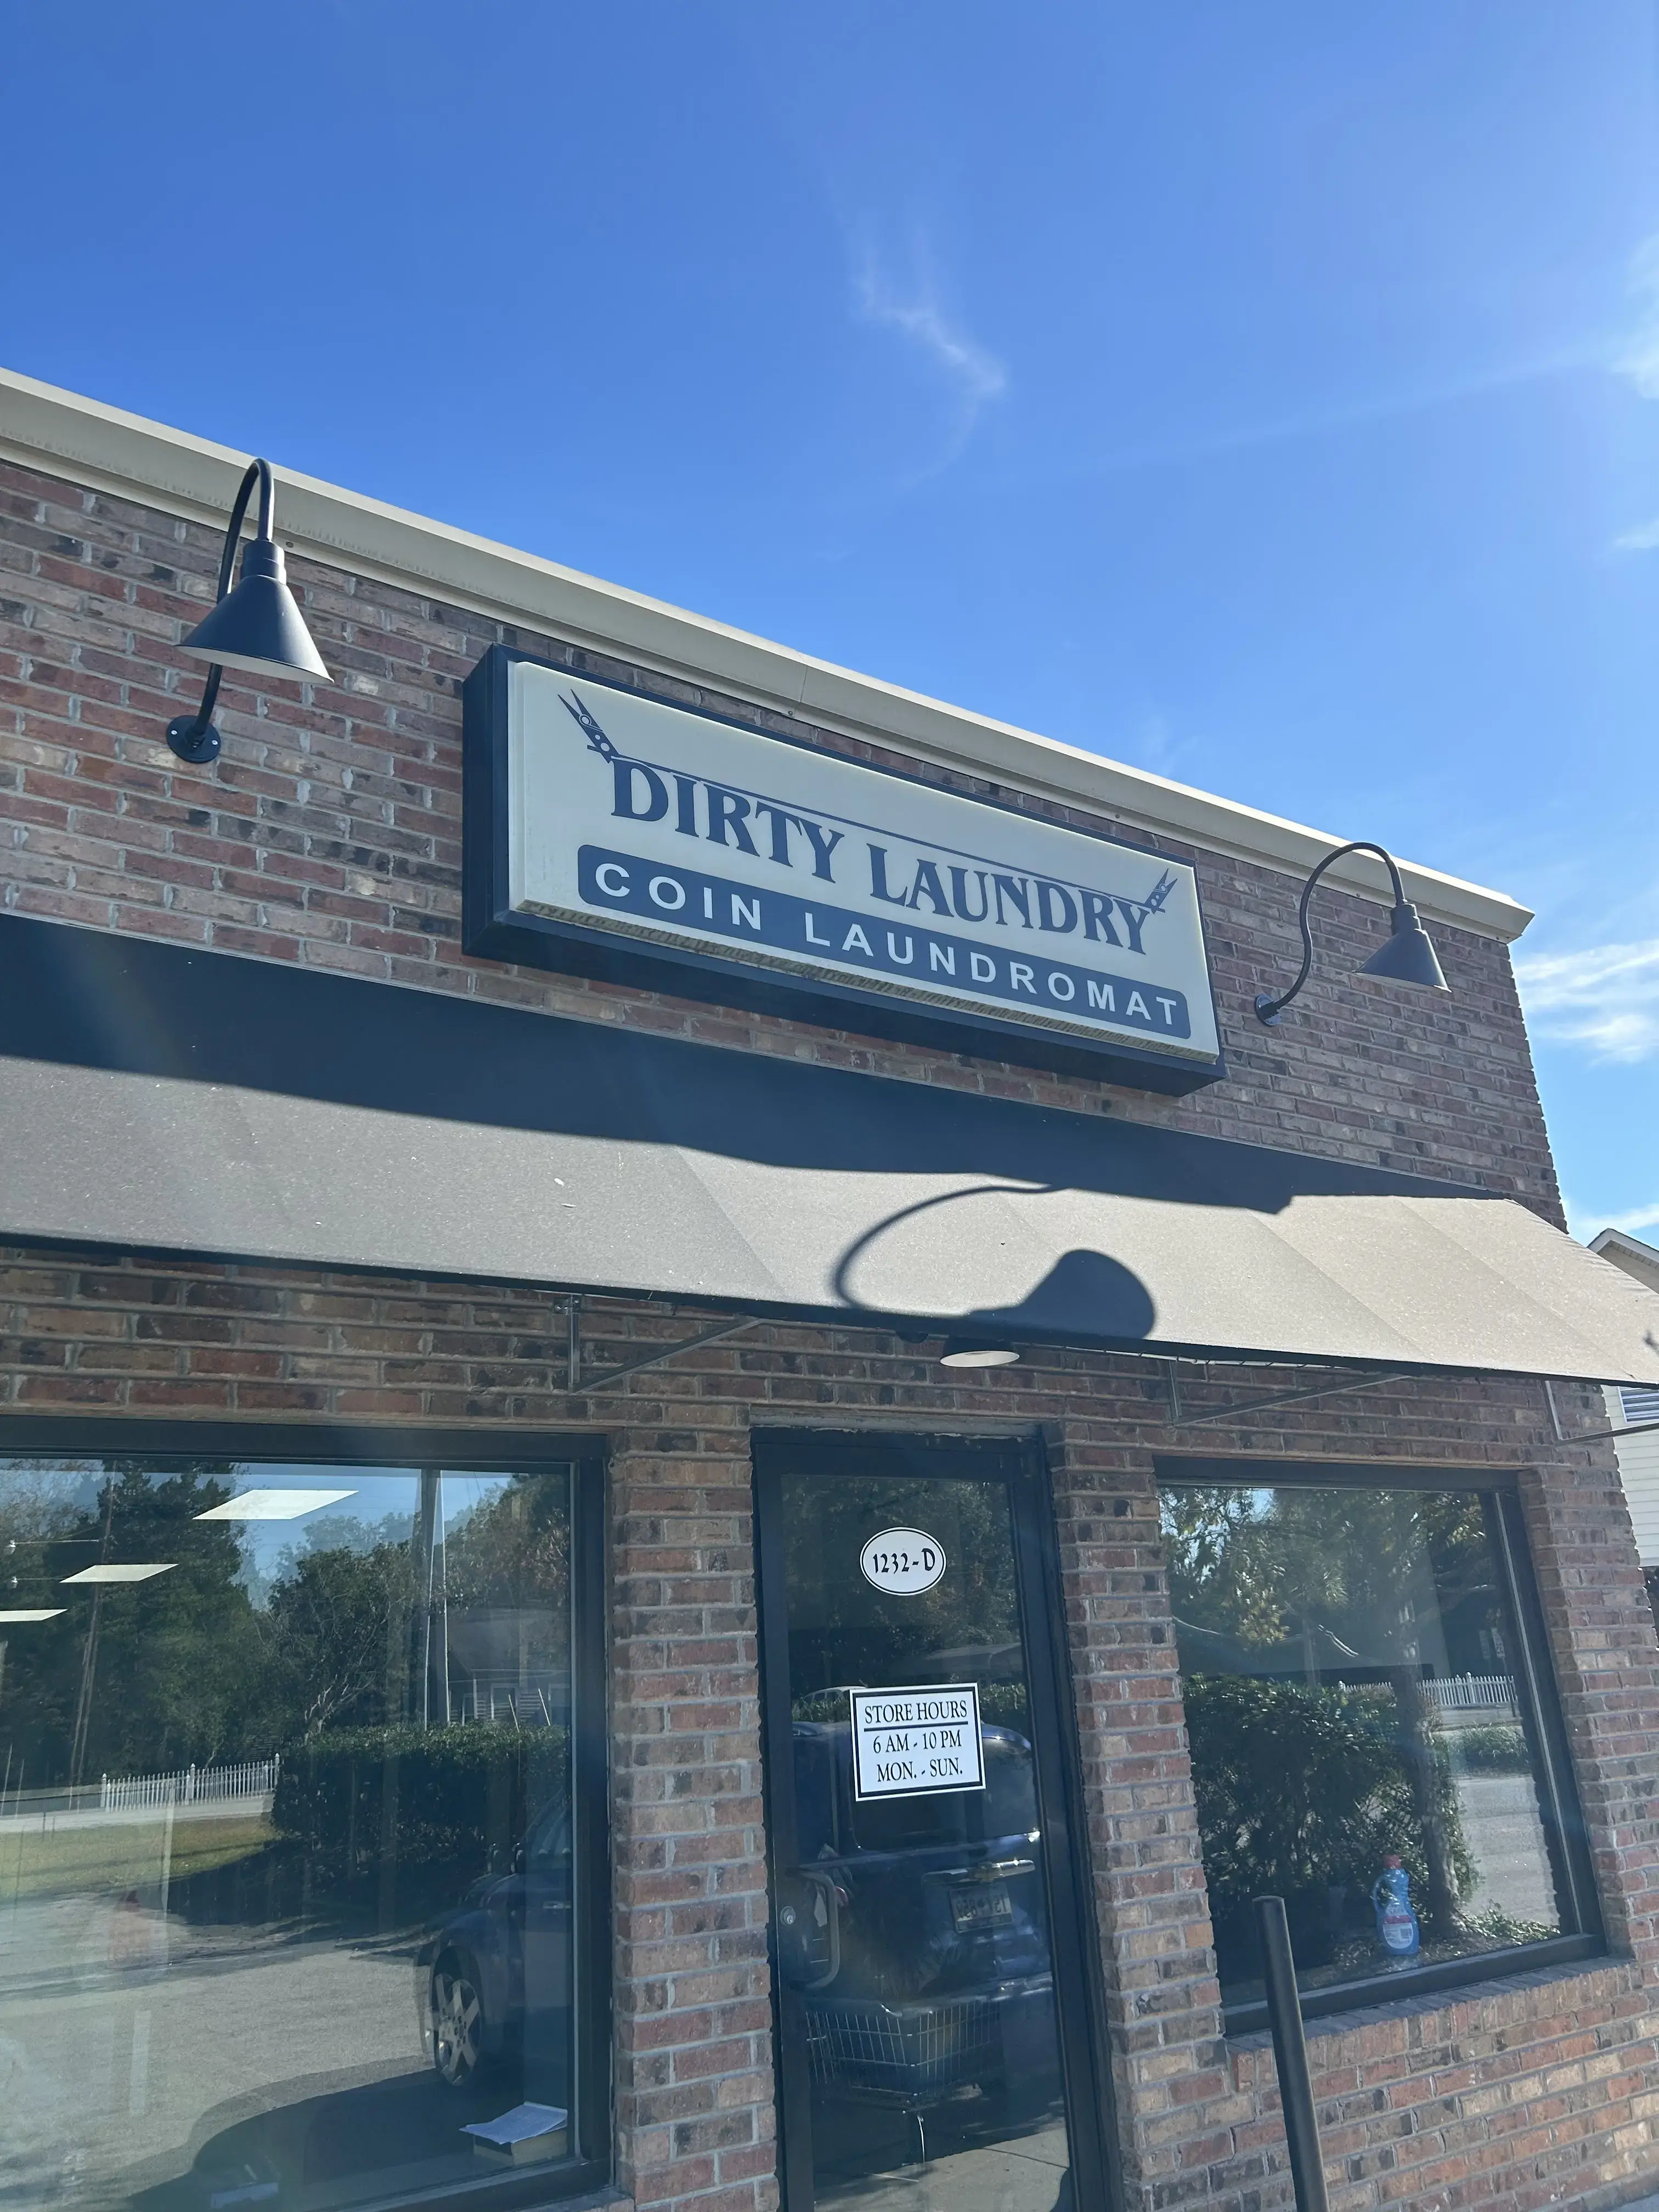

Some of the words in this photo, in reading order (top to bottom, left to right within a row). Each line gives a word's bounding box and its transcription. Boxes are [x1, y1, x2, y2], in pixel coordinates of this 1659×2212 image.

[611, 757, 845, 884] DIRTY
[866, 843, 1150, 956] LAUNDRY
[595, 862, 761, 930] COIN
[804, 911, 1177, 1025] LAUNDROMAT
[872, 1548, 935, 1574] 1232-D
[865, 1703, 913, 1724] STORE
[916, 1700, 967, 1720] HOURS
[873, 1735, 881, 1754] 6
[885, 1733, 910, 1753] AM
[922, 1731, 937, 1750] 10
[940, 1729, 962, 1748] PM
[877, 1760, 917, 1782] MON.
[929, 1757, 963, 1777] SUN.
